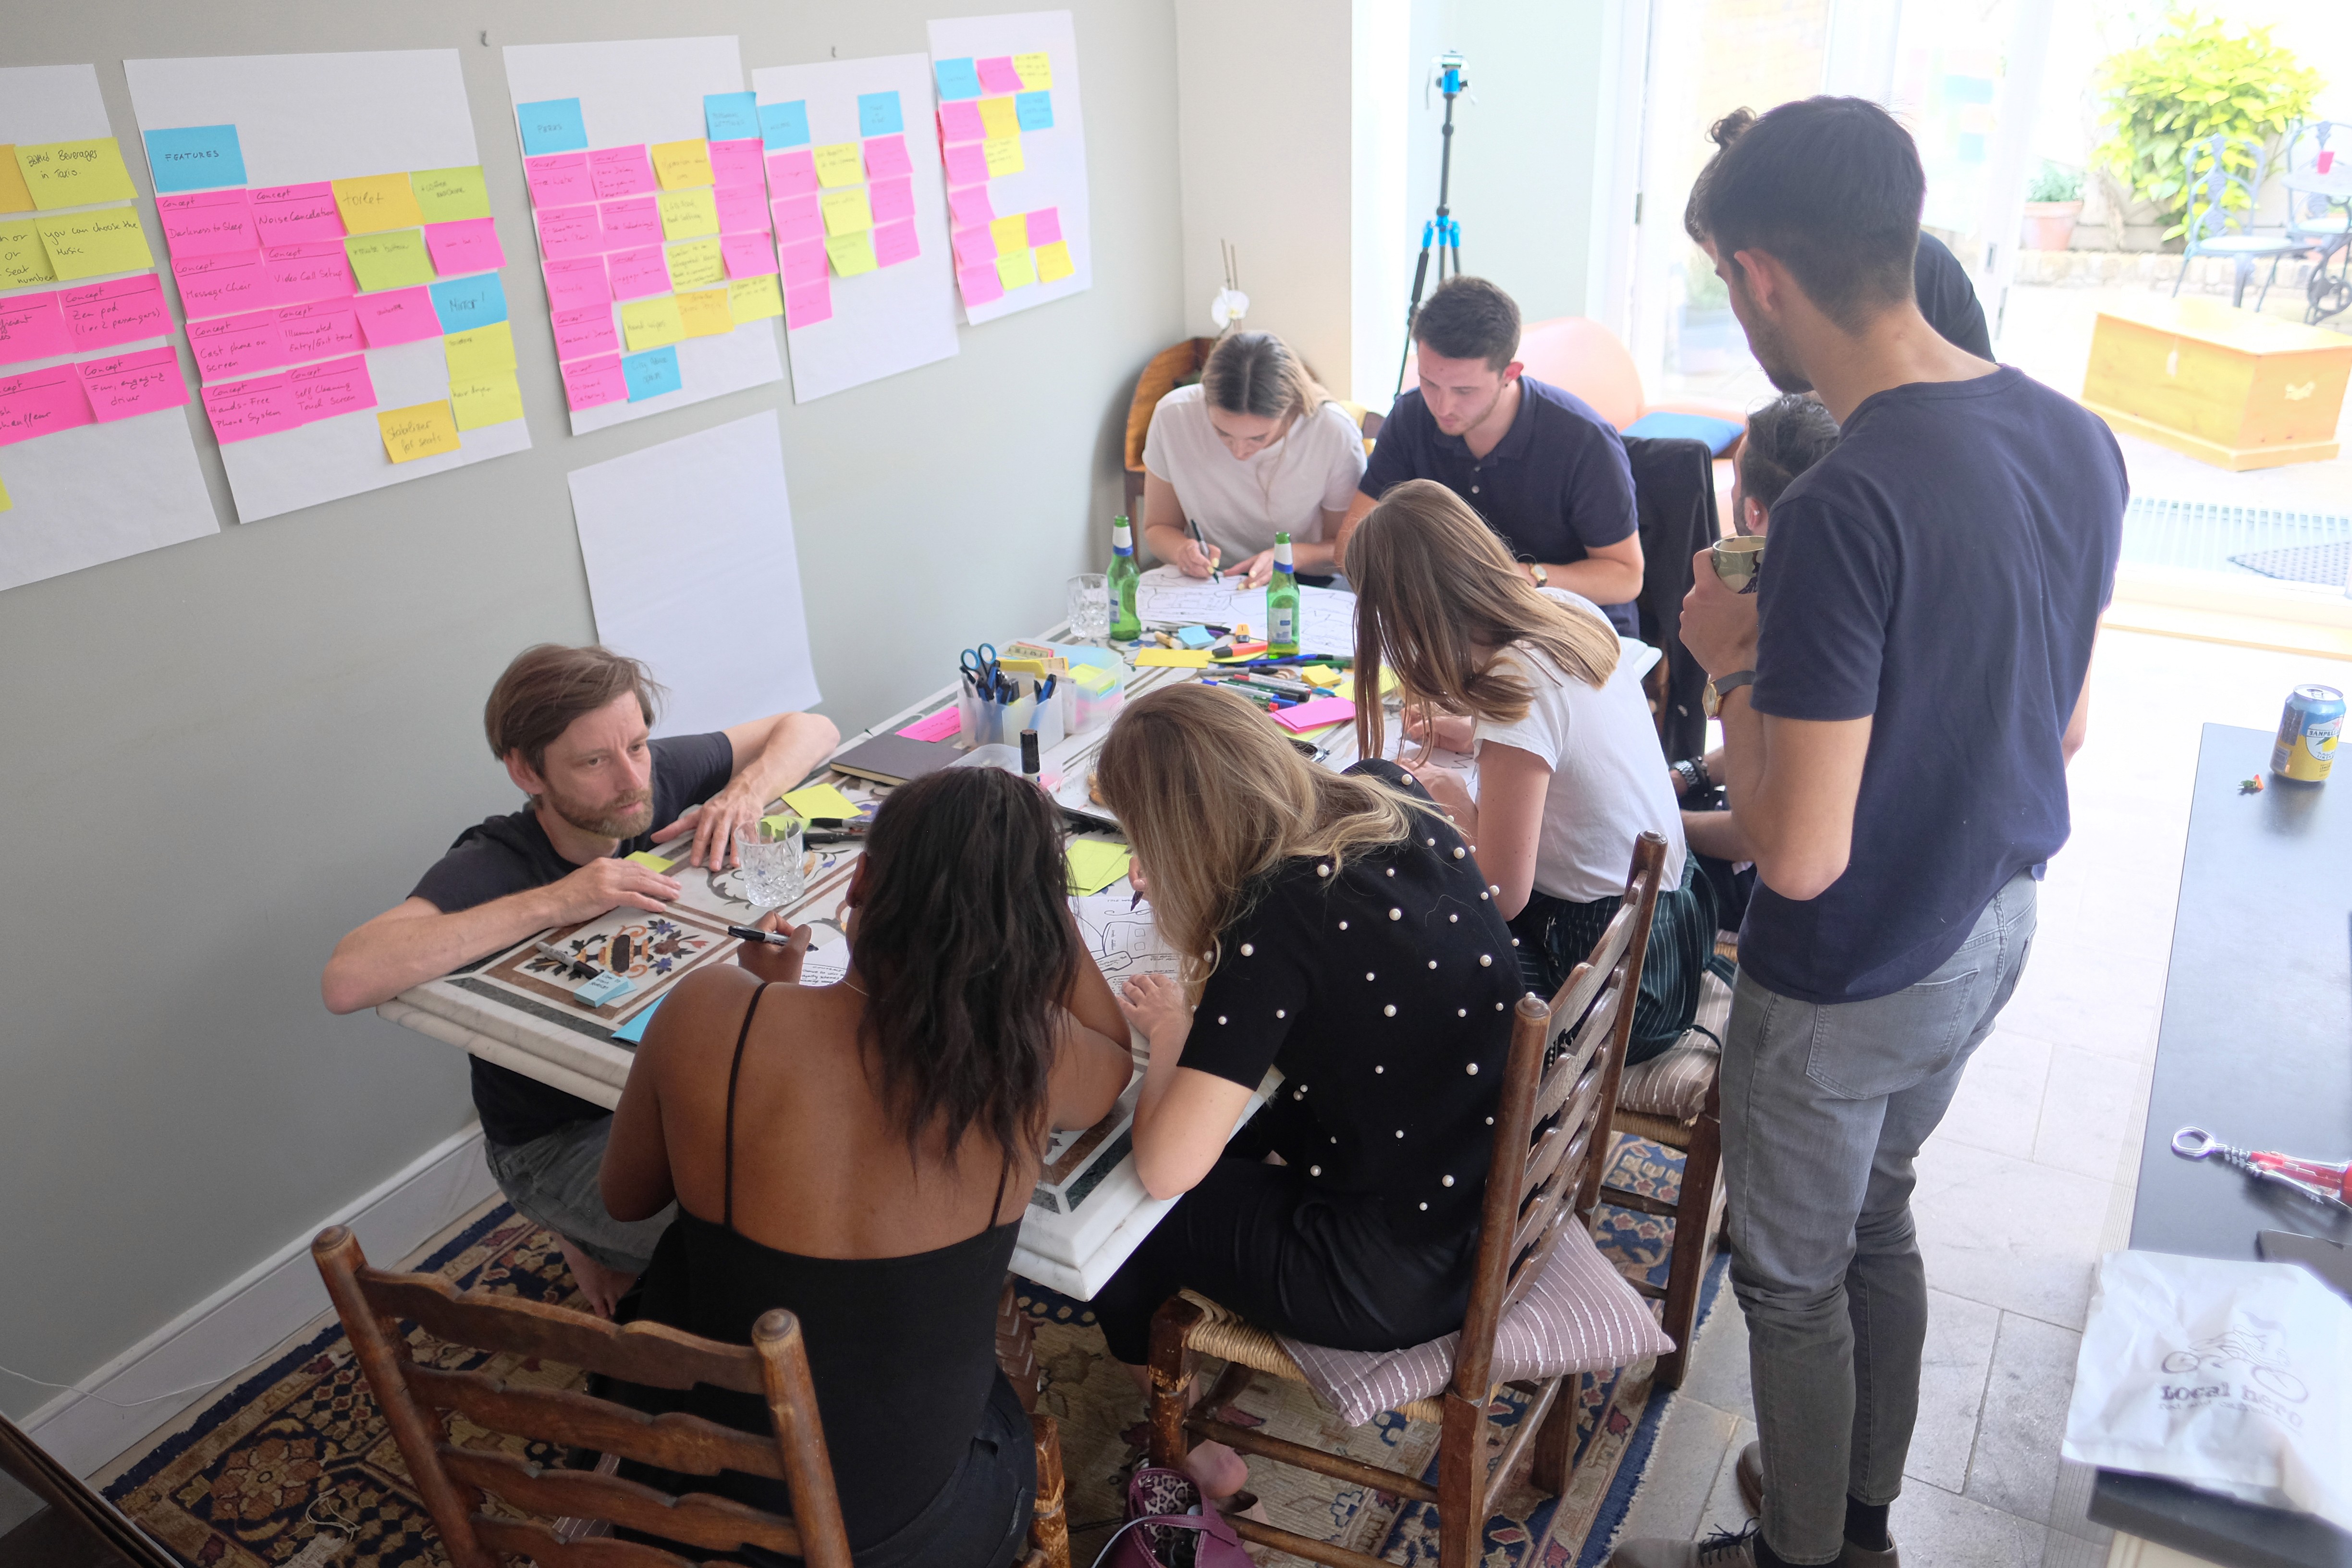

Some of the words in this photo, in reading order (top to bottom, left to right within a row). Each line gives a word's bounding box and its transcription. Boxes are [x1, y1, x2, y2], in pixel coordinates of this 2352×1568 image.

[58, 149, 97, 162] Beverages
[165, 150, 220, 161] FEATURES
[40, 170, 49, 179] in
[257, 189, 291, 201] Concept
[162, 197, 195, 208] Concept
[93, 221, 120, 233] choose
[122, 220, 138, 230] the
[258, 216, 288, 225] Noise
[214, 222, 220, 231] to
[223, 222, 243, 235] Sleep
[268, 247, 302, 259] Concept
[174, 260, 215, 274] Concept
[17, 273, 55, 283] number
[274, 273, 297, 283] Video
[65, 286, 105, 303] Concept
[279, 306, 314, 319] Concept
[195, 322, 233, 336] Concept
[285, 322, 332, 338] Illuminated
[85, 360, 123, 377] Concept
[290, 367, 322, 380] Concept
[212, 383, 248, 397] Concept
[111, 394, 140, 406] driver
